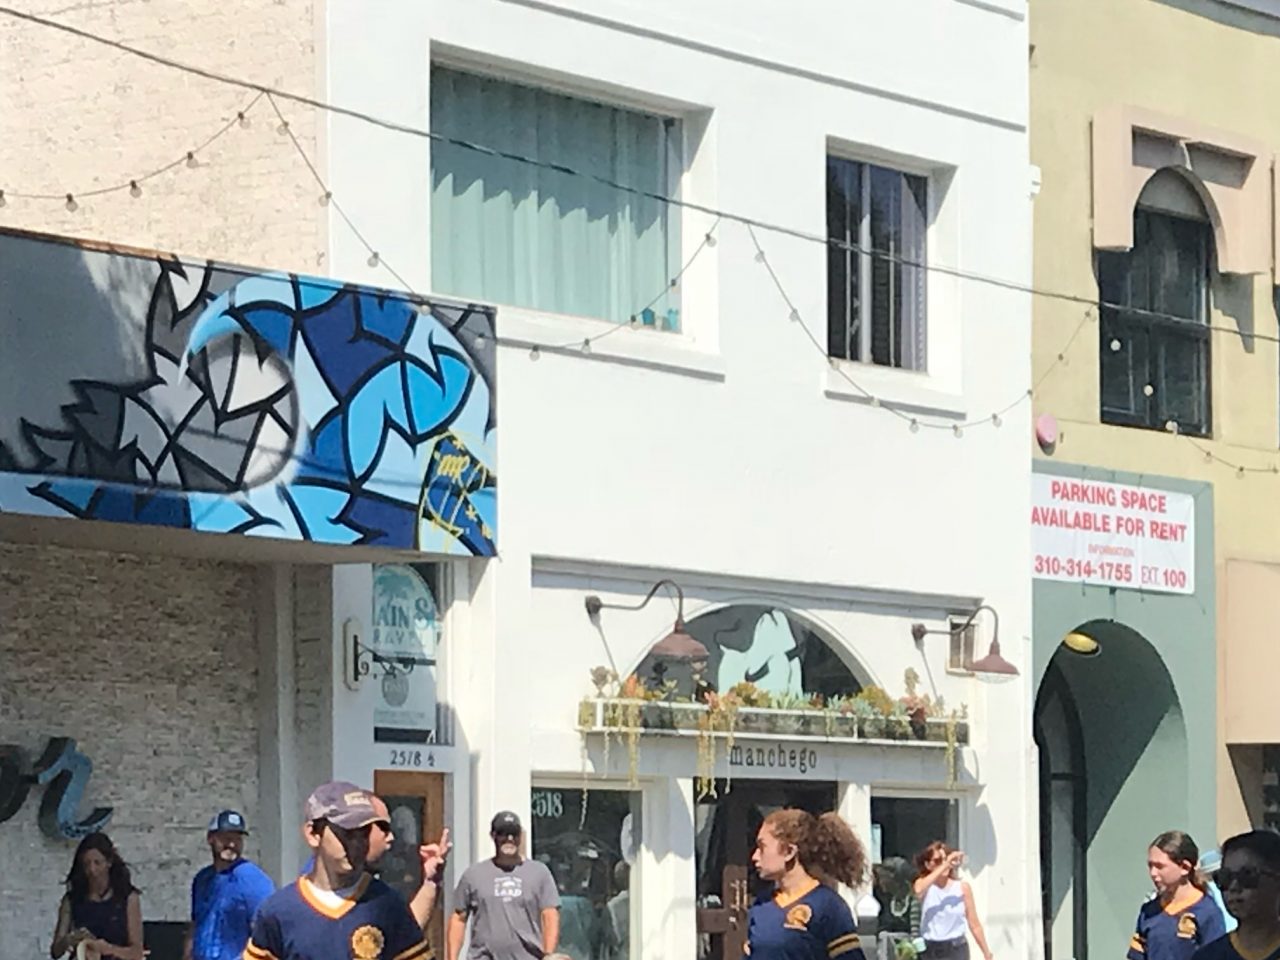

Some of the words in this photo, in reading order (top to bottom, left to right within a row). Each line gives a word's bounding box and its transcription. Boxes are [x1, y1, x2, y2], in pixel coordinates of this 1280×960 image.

[1051, 480, 1116, 507] PARKING
[1121, 489, 1167, 513] SPACE
[1031, 506, 1111, 533] AVAILABLE
[1116, 515, 1145, 537] FOR
[1150, 520, 1187, 542] RENT
[1034, 554, 1132, 582] 310-314-1755
[1163, 568, 1187, 588] 100
[389, 748, 422, 767] 2518
[729, 743, 817, 774] manchego
